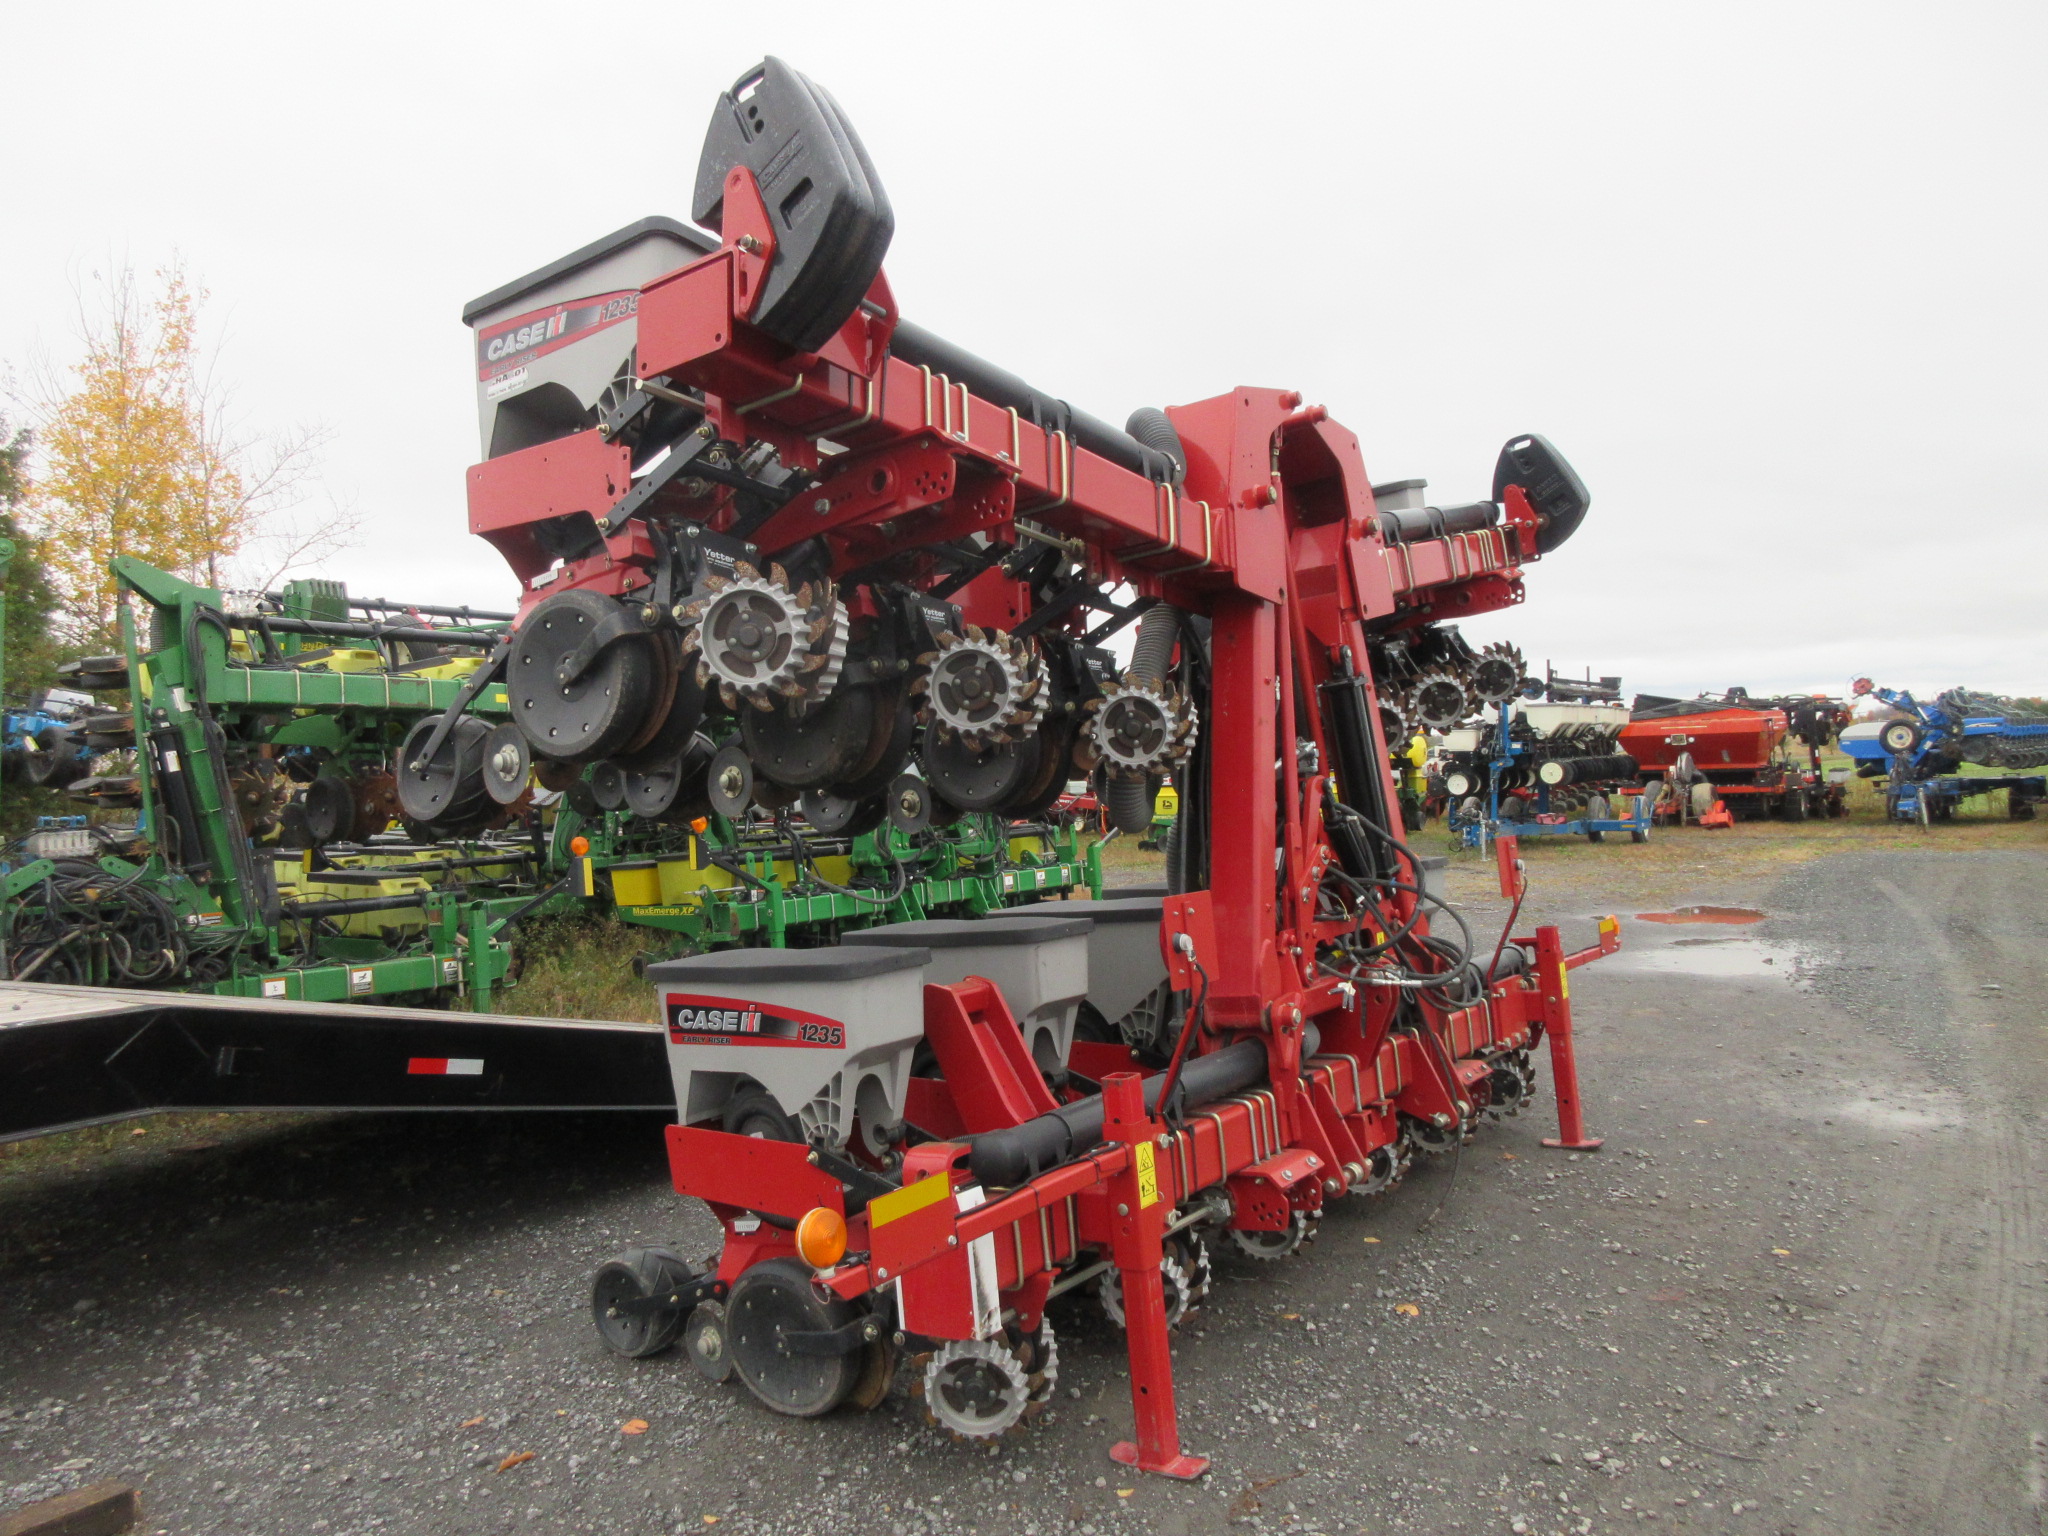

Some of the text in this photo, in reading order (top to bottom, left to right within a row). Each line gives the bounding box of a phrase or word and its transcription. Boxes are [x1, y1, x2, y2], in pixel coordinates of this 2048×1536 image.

[602, 294, 640, 322] 1235
[488, 320, 545, 361] CASE
[704, 547, 735, 563] Yetter
[922, 606, 946, 617] Yetter
[633, 906, 695, 916] MaxEmerge XP
[678, 1009, 739, 1031] CASE
[682, 1035, 731, 1045] EARLY RISER
[800, 1023, 842, 1046] 1235
